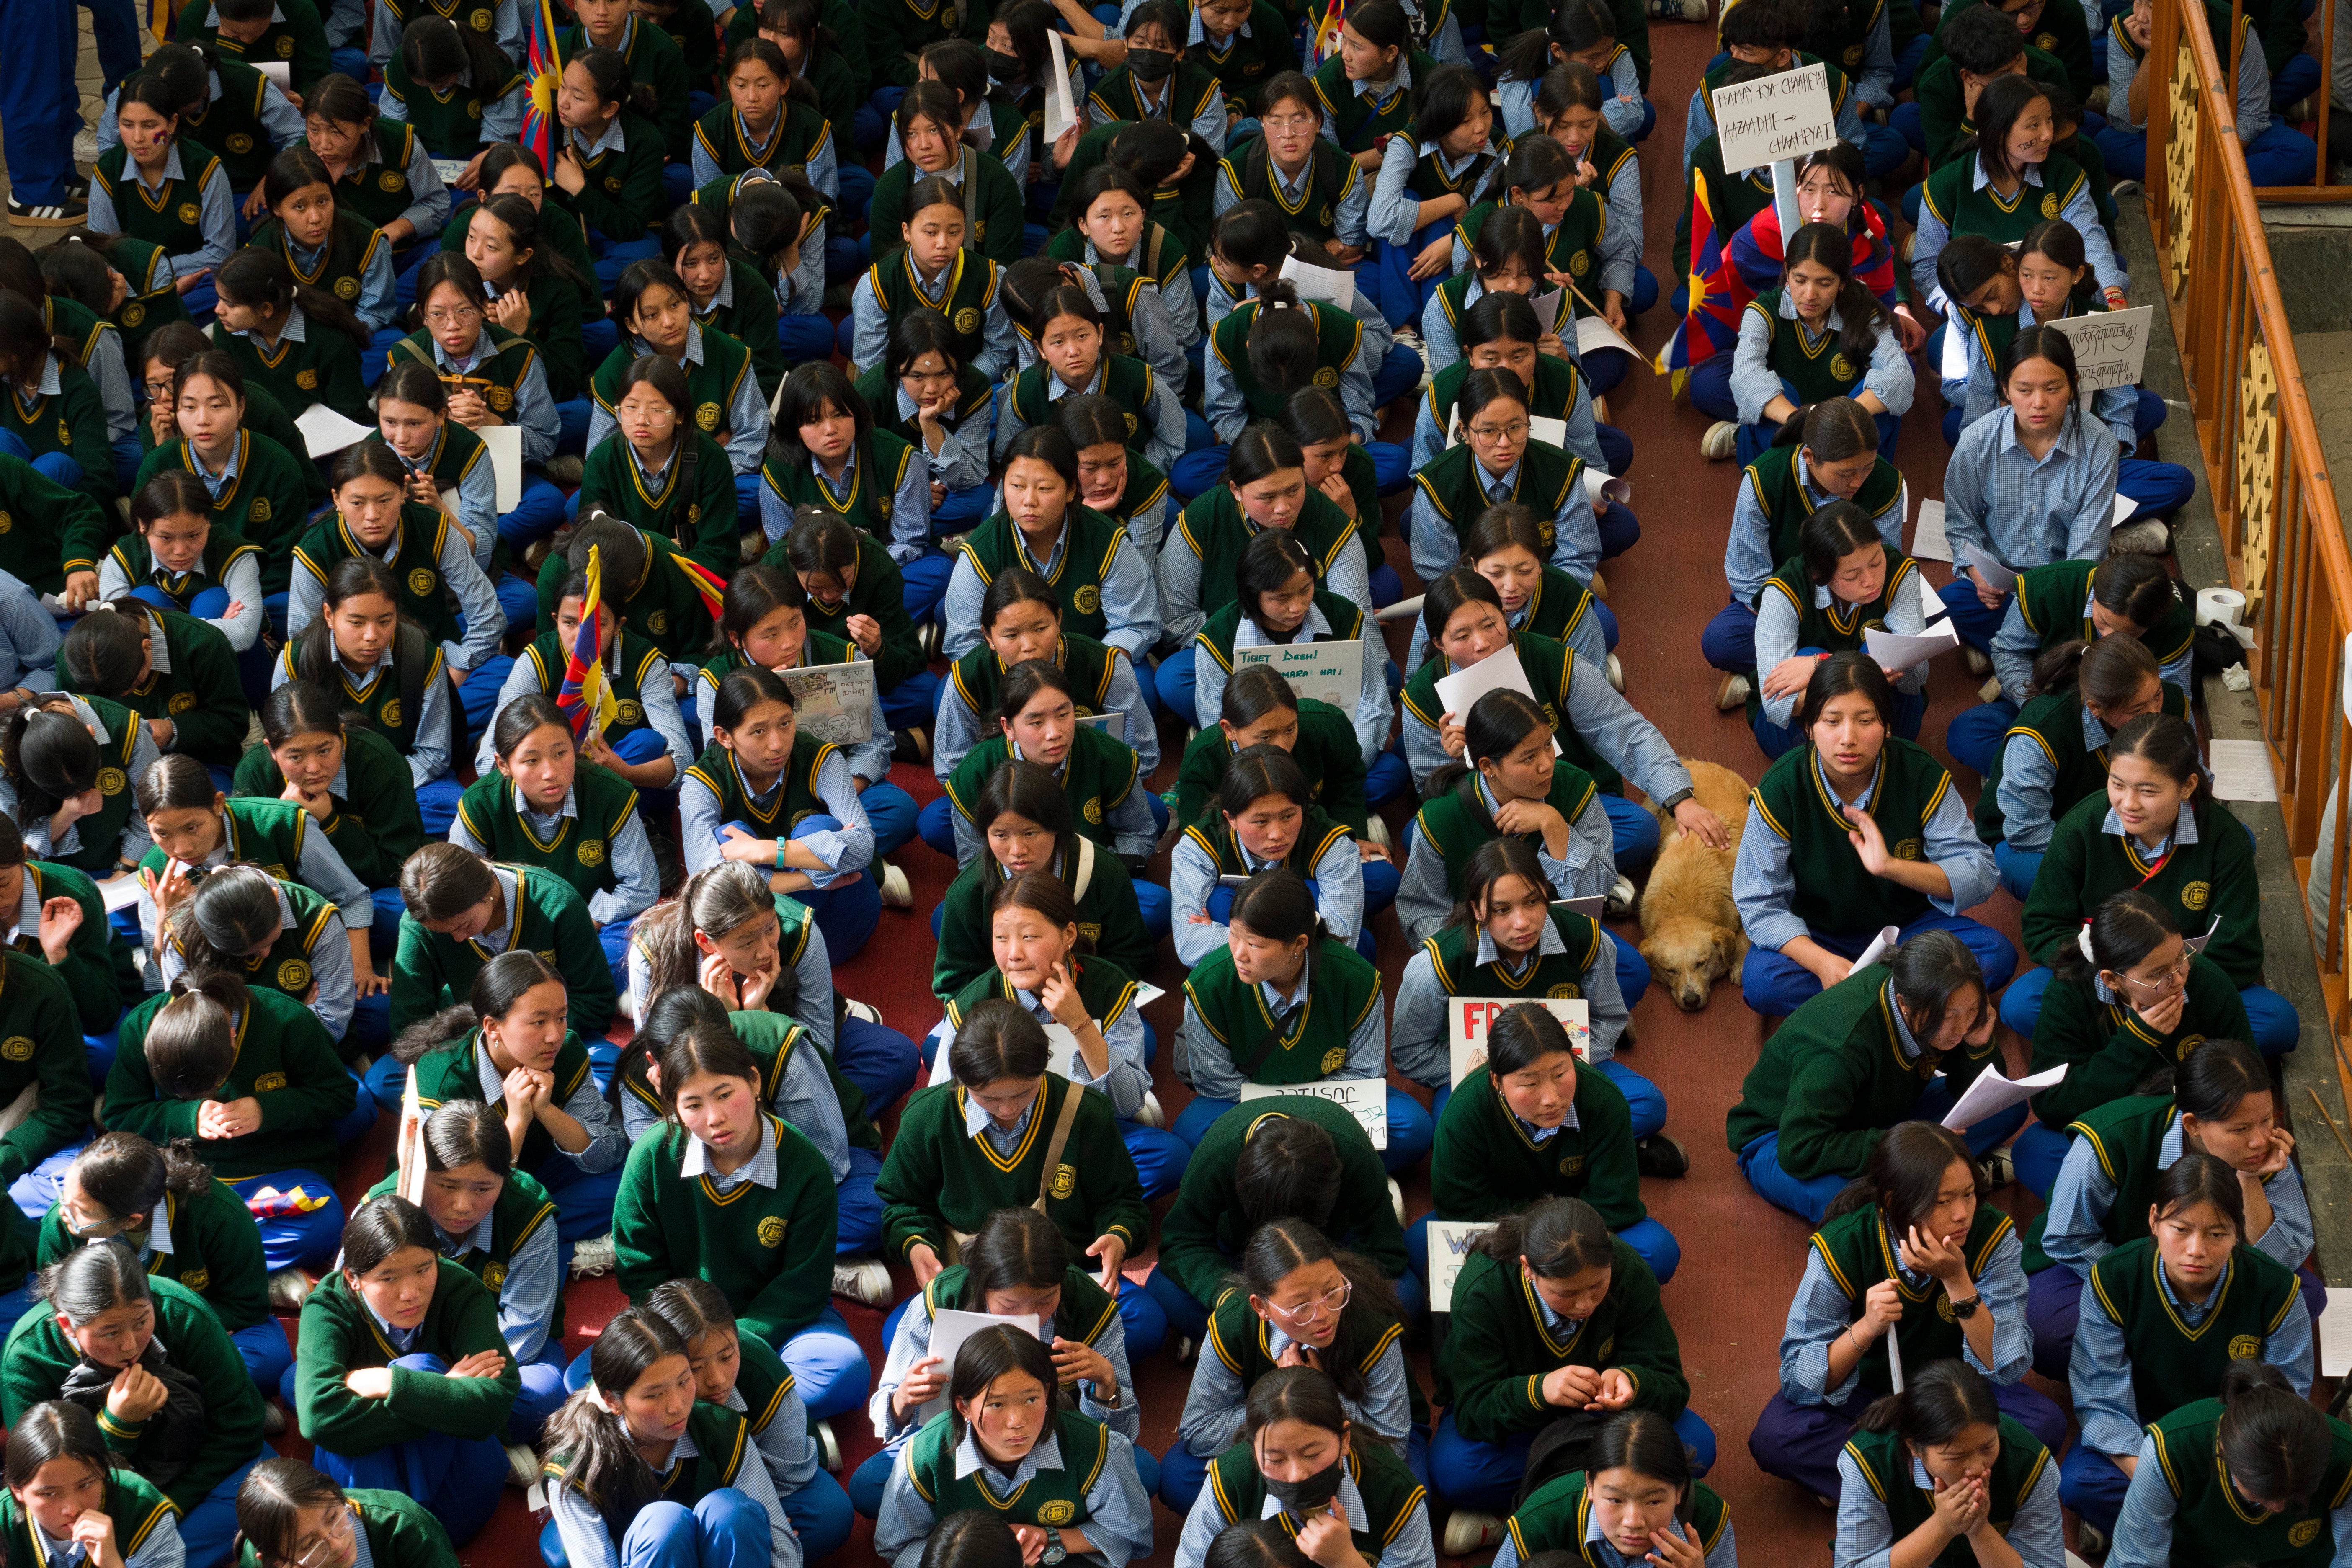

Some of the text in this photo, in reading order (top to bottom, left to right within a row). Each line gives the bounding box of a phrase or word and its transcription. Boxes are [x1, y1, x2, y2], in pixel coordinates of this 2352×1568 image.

[1717, 85, 1752, 108] HAMAY
[1756, 82, 1779, 101] KYA
[1238, 651, 1271, 663] TIBET
[1279, 670, 1308, 678] MARA
